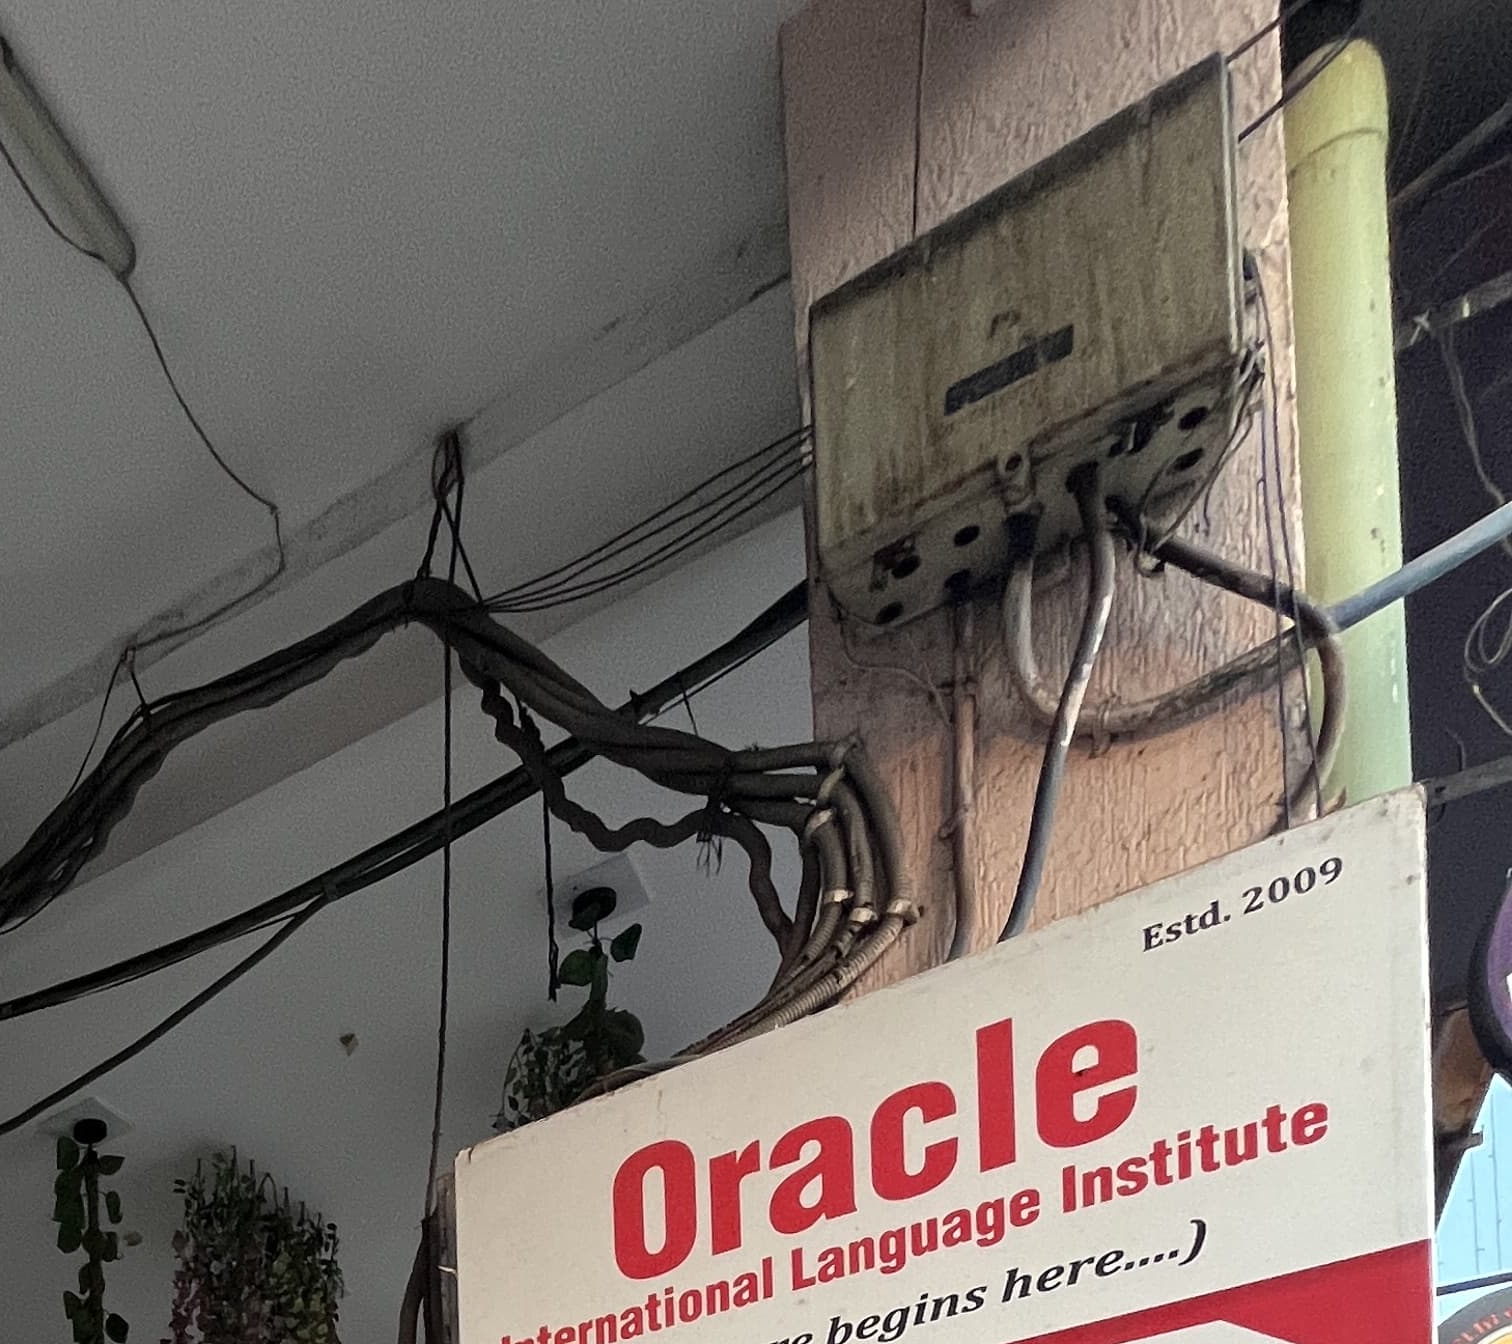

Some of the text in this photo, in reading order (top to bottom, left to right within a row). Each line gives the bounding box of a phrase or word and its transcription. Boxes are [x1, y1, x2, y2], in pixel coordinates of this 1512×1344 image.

[1141, 856, 1344, 952] Estd. 2009
[612, 1014, 1139, 1281] Oracle
[790, 1188, 1040, 1289] Language
[1061, 1100, 1330, 1213] Institute
[1001, 1219, 1210, 1304] here....)
